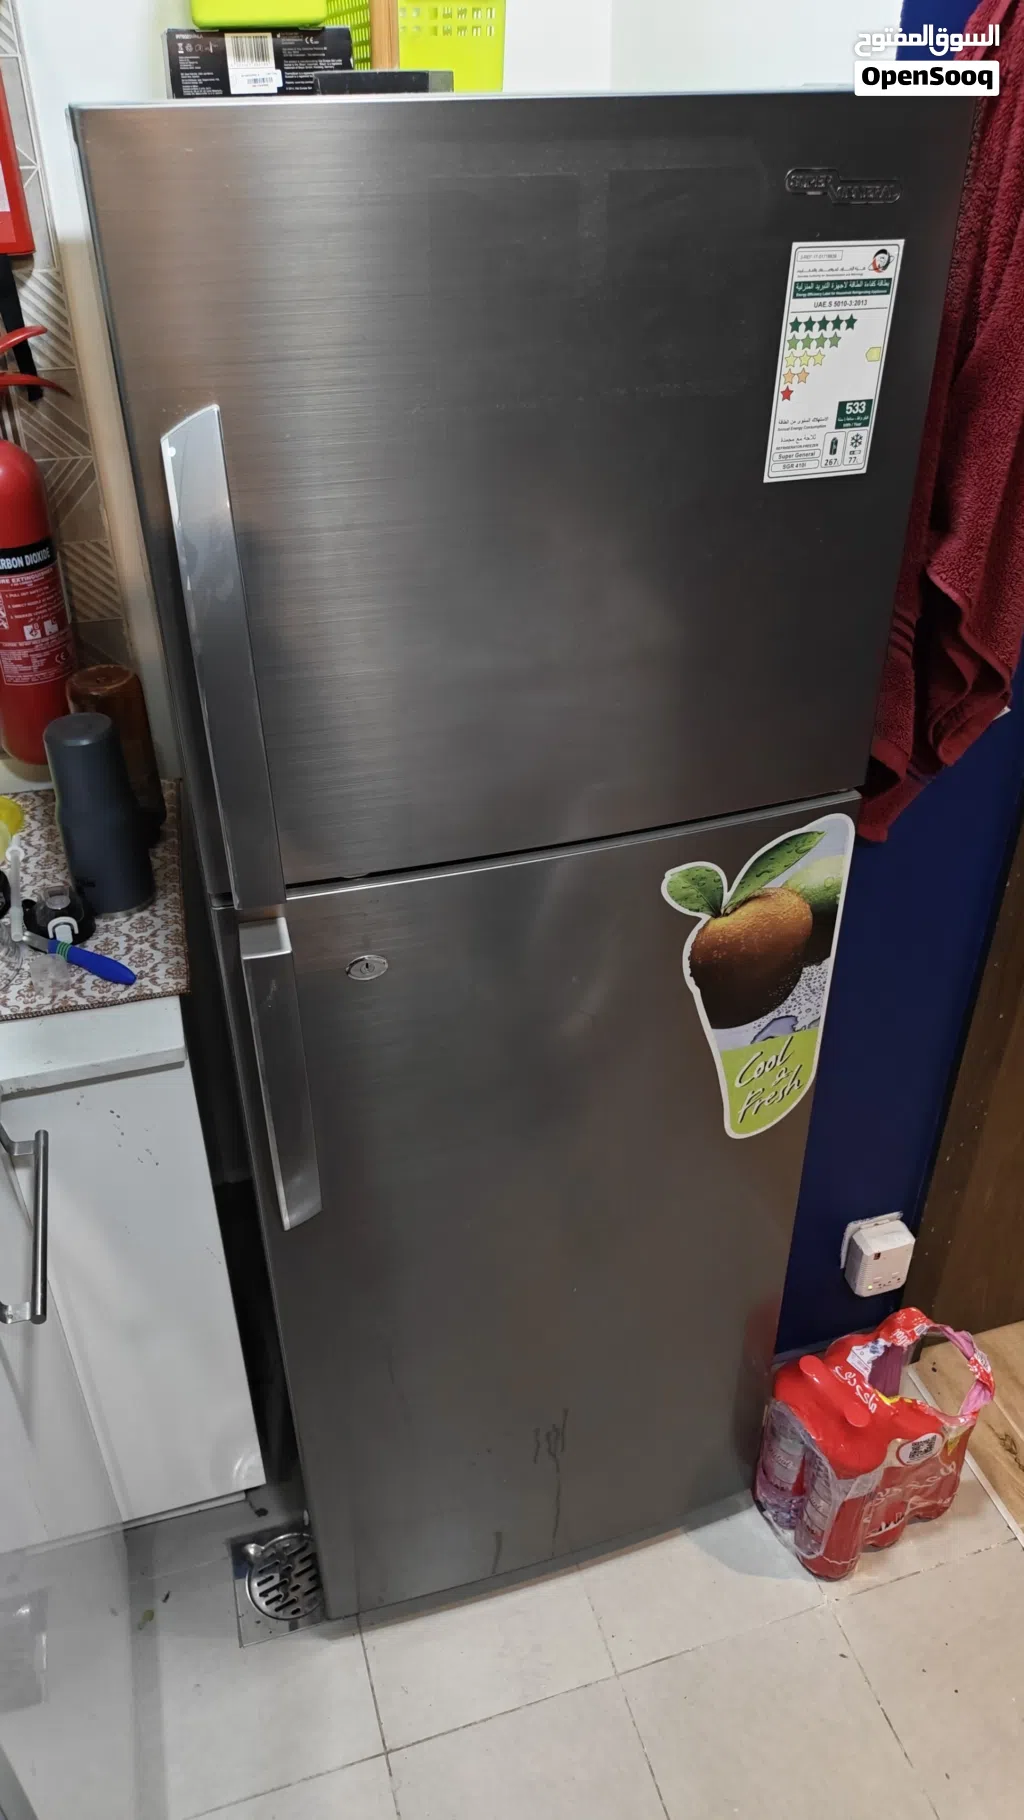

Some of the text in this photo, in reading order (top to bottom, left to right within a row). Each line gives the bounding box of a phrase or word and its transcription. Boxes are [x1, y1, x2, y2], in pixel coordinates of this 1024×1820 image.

[845, 401, 866, 415] 533
[24, 547, 51, 566] DIOXIDE
[735, 1036, 795, 1088] Cool
